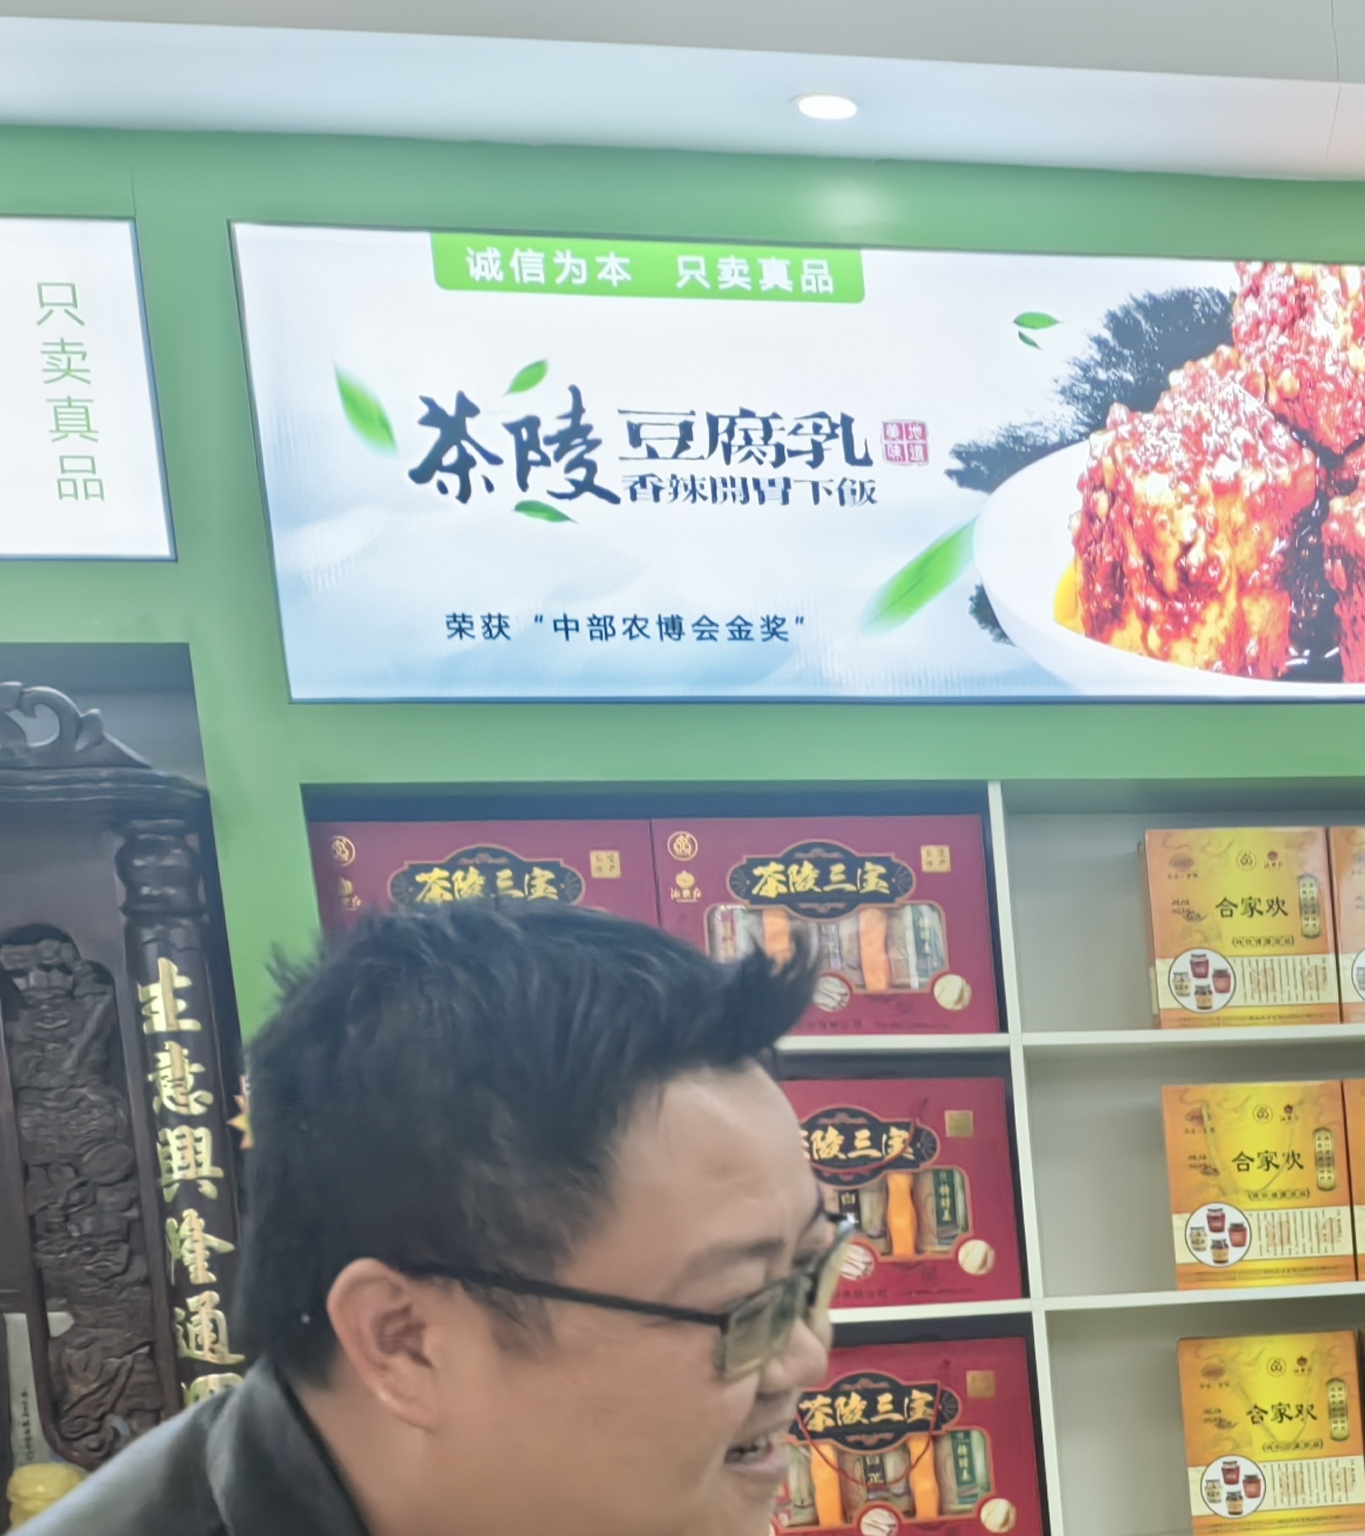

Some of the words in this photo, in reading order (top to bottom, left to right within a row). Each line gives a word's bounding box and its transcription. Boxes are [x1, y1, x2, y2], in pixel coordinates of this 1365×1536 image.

[465, 246, 633, 288] 诚信为本
[675, 252, 835, 295] 只卖真品
[35, 281, 106, 501] 只卖真品
[408, 384, 621, 506] 茶陵
[617, 406, 875, 468] 豆腐乳
[751, 861, 890, 898] 茶陵三宝
[1214, 897, 1290, 920] 合家欢
[1231, 1149, 1304, 1173] 合家欢
[798, 1389, 934, 1432] 茶陵三宝
[1246, 1402, 1318, 1425] 合家欢
